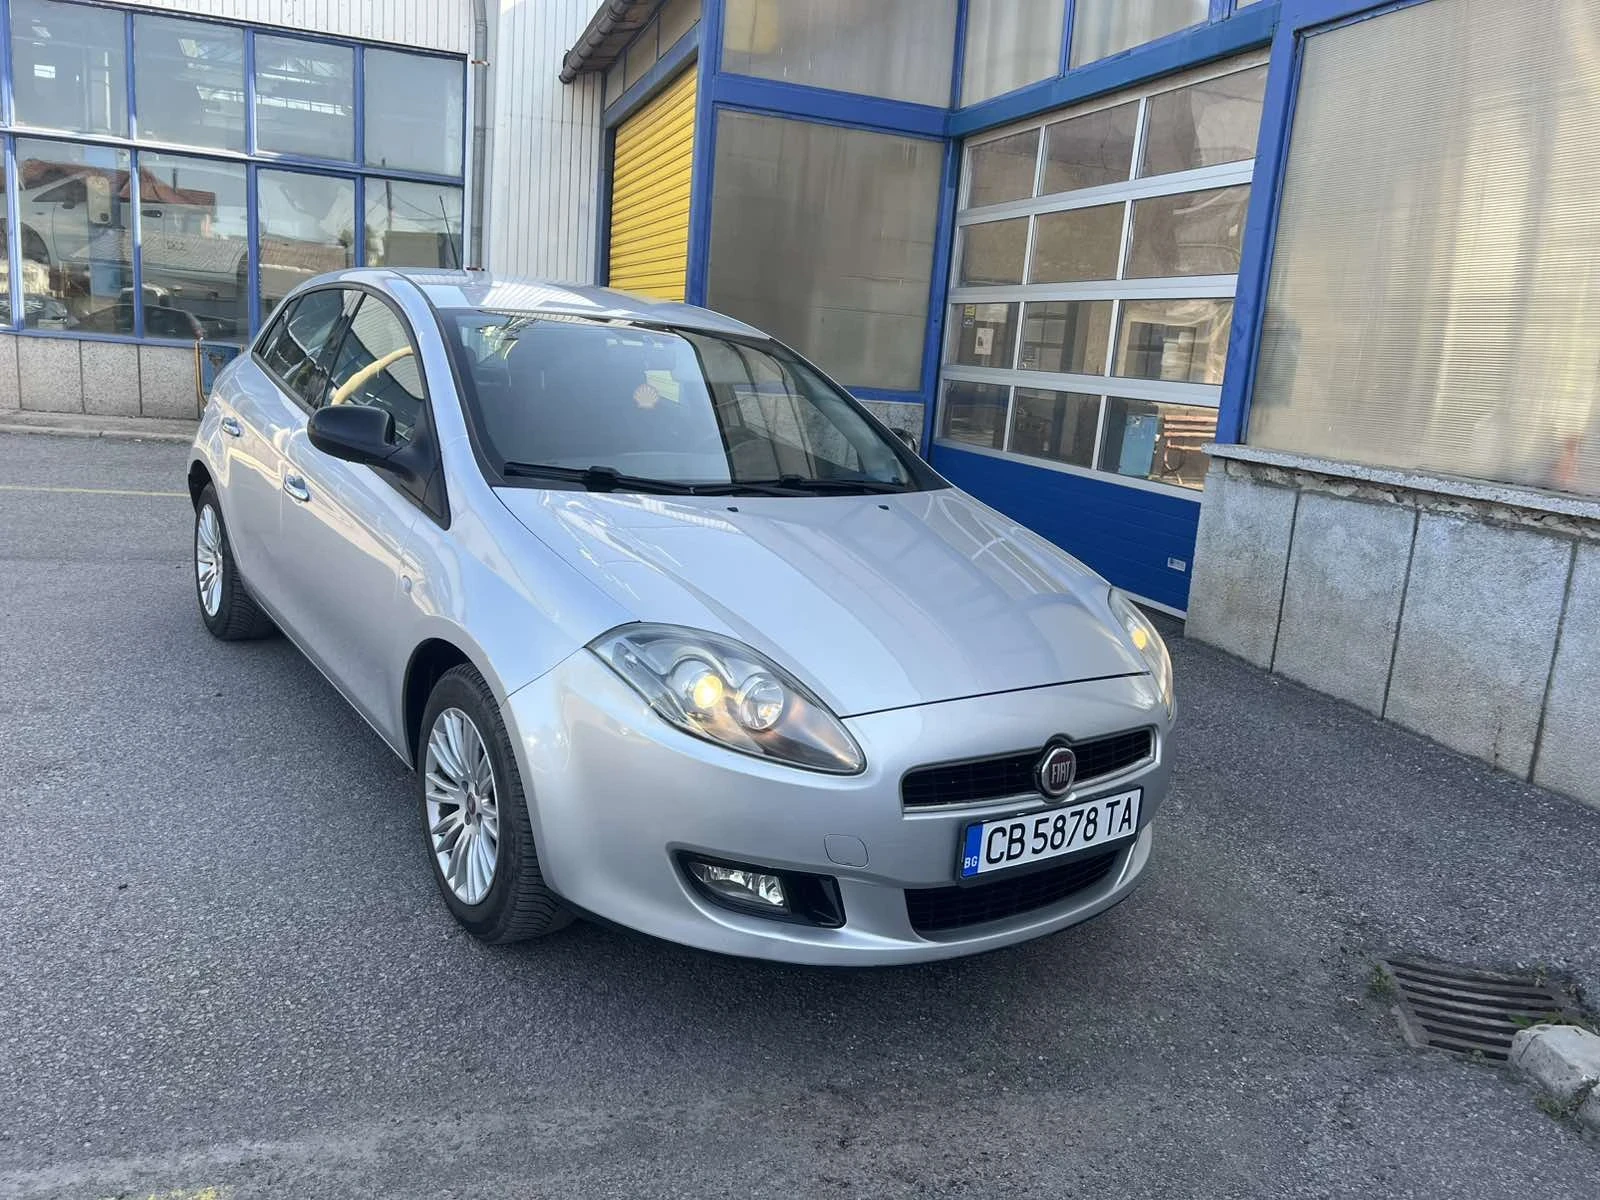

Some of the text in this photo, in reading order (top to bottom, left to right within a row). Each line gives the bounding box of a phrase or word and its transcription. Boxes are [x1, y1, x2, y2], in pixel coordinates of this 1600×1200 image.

[1051, 761, 1071, 784] FIAT
[985, 797, 1132, 864] CB 5878 TA
[964, 856, 978, 868] BG
